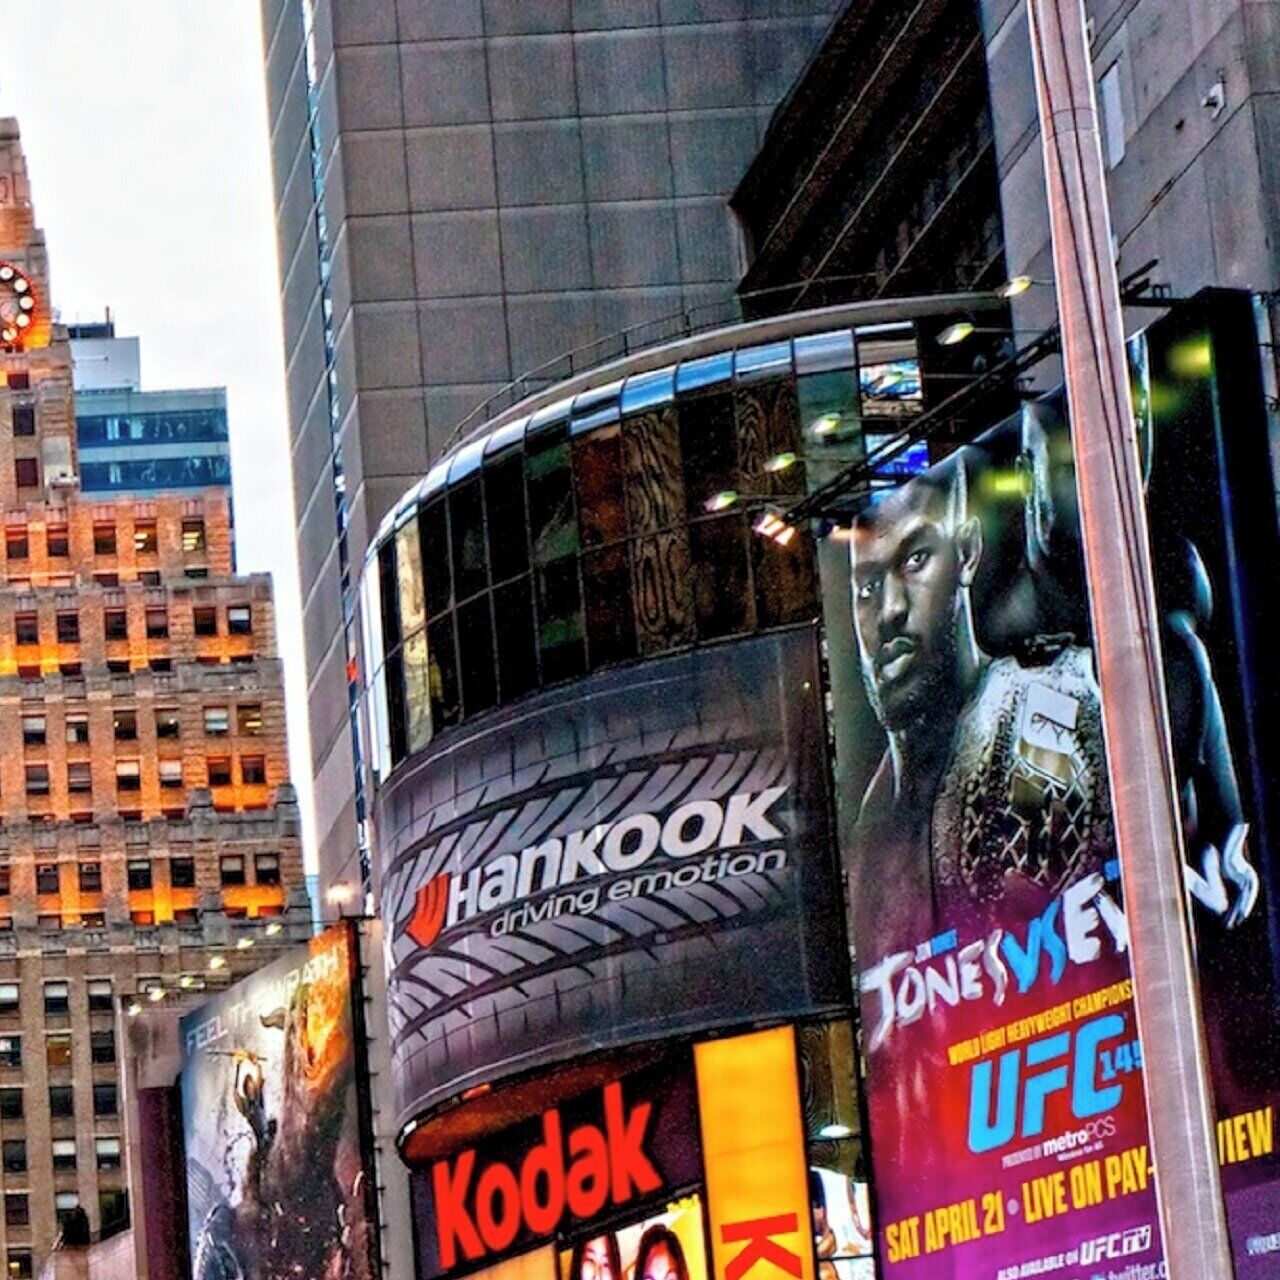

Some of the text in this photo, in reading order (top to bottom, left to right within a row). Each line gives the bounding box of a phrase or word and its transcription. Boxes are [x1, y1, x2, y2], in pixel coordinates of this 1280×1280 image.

[491, 847, 787, 937] driving emotion
[186, 1015, 229, 1056] FEEL
[861, 929, 1007, 1054] JONES
[948, 1036, 980, 1066] WORLD
[982, 1026, 1006, 1056] LIGHT
[1007, 1000, 1072, 1050] HEAVYWEIGHT
[968, 1015, 1126, 1153] UFC
[432, 1082, 663, 1270] Kodak
[1044, 1115, 1116, 1156] metroPCS
[885, 1213, 922, 1264] SAT
[924, 1204, 980, 1255] APRIL
[981, 1195, 1006, 1235] 21
[1022, 1169, 1065, 1224] LIVE
[1067, 1160, 1102, 1212] ON
[1021, 1254, 1065, 1279] AVAILABLE
[1080, 1233, 1121, 1266] UFC
